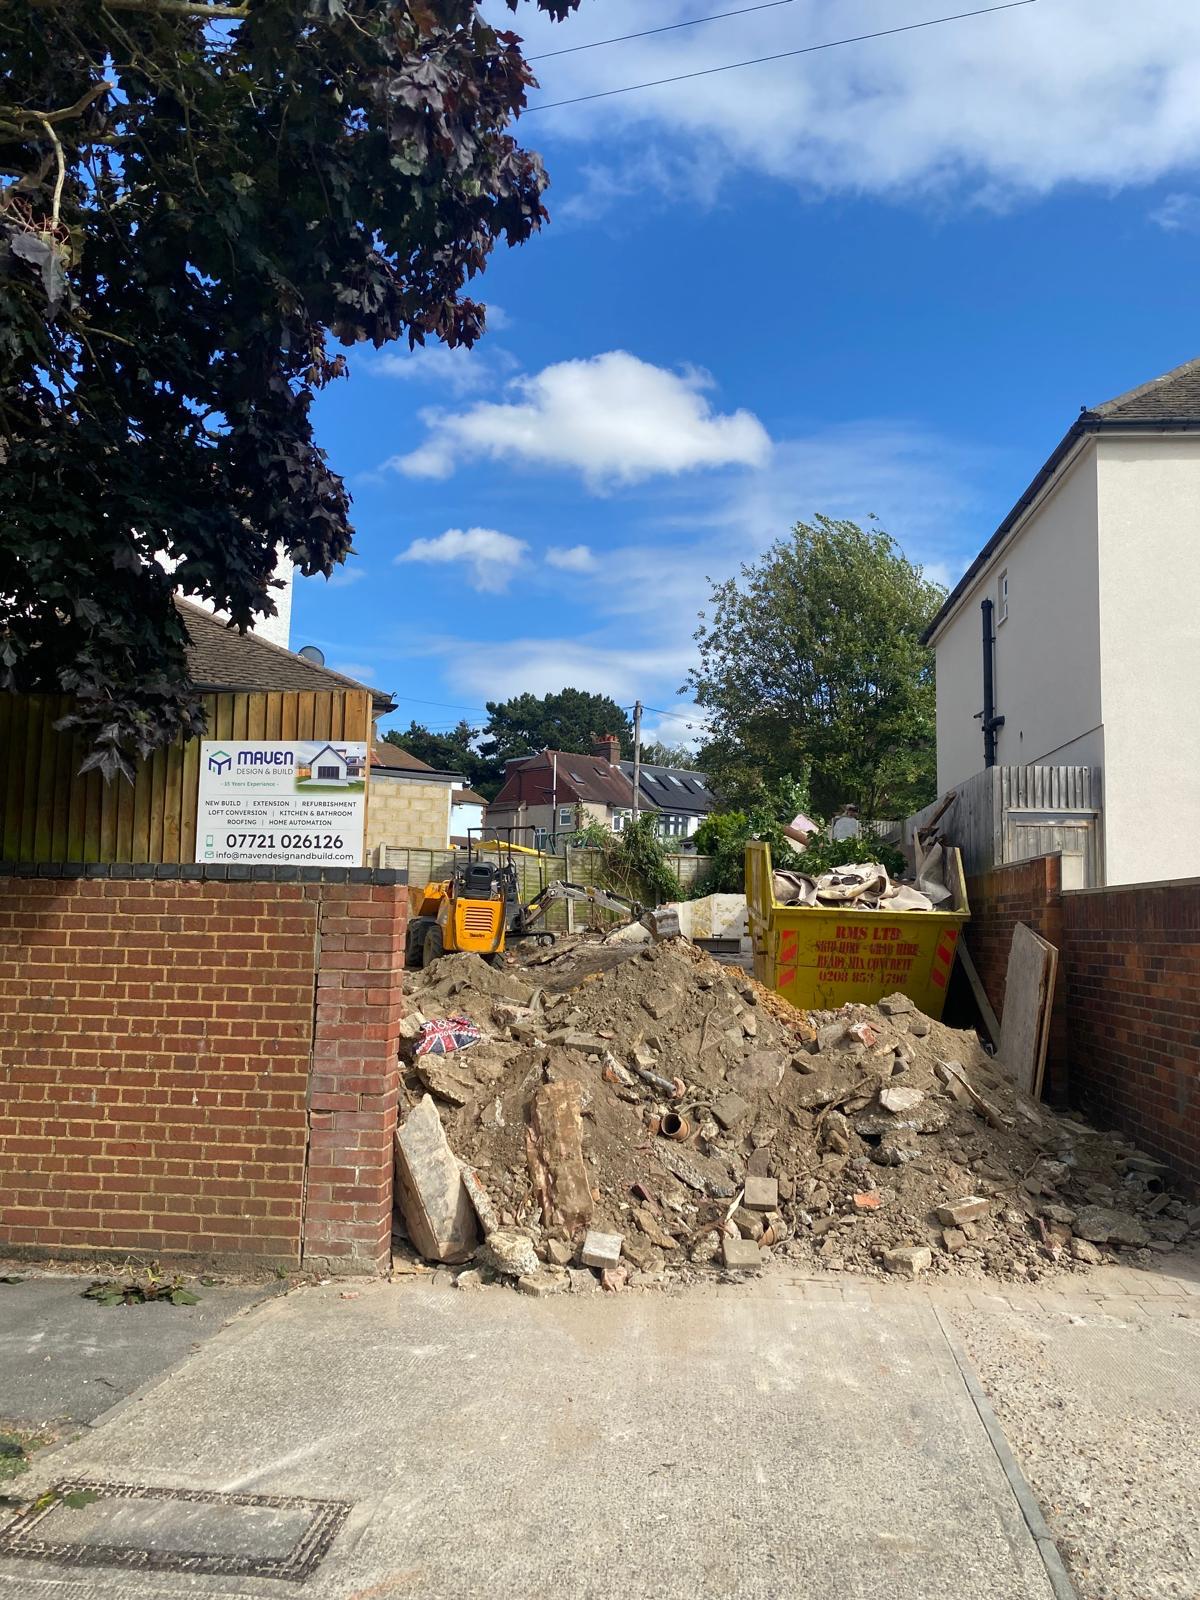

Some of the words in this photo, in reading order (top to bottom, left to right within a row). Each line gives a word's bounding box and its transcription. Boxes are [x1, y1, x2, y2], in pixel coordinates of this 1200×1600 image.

[237, 751, 294, 765] MAVEN
[226, 834, 276, 848] 07721
[281, 834, 344, 849] 026126
[216, 851, 354, 860] info@mavendesignandbuild.com
[836, 926, 868, 939] RMS
[872, 927, 902, 940] LTD
[896, 943, 919, 956] HIRE
[818, 970, 848, 982] 0208
